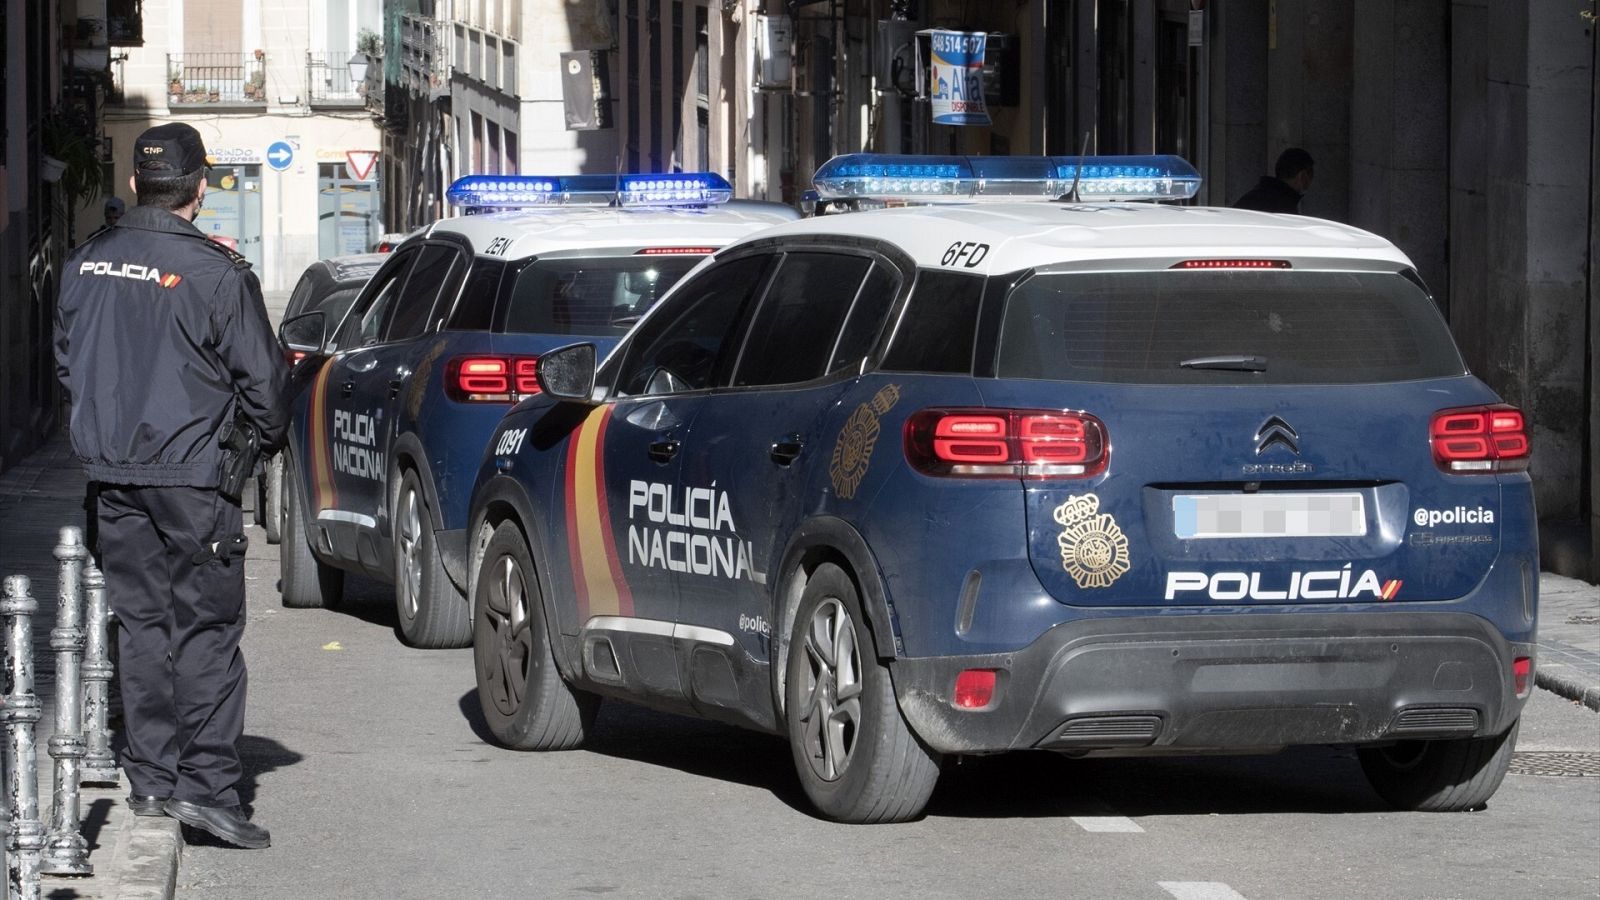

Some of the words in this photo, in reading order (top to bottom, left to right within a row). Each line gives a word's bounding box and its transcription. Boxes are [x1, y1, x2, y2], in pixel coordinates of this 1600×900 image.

[945, 36, 961, 53] 514
[962, 37, 982, 54] 507
[143, 146, 163, 154] CNP
[207, 148, 253, 157] ARINDO
[216, 156, 261, 165] express
[485, 237, 514, 256] 2EN
[941, 241, 990, 268] 6FD
[80, 262, 160, 283] POLICIA
[334, 409, 376, 447] POLICÍA
[334, 441, 386, 484] NACIONAL
[629, 479, 736, 532] POLICÍA
[1414, 506, 1494, 527] @policia
[629, 524, 767, 584] NACIONAL
[1165, 562, 1383, 600] POLICÍA
